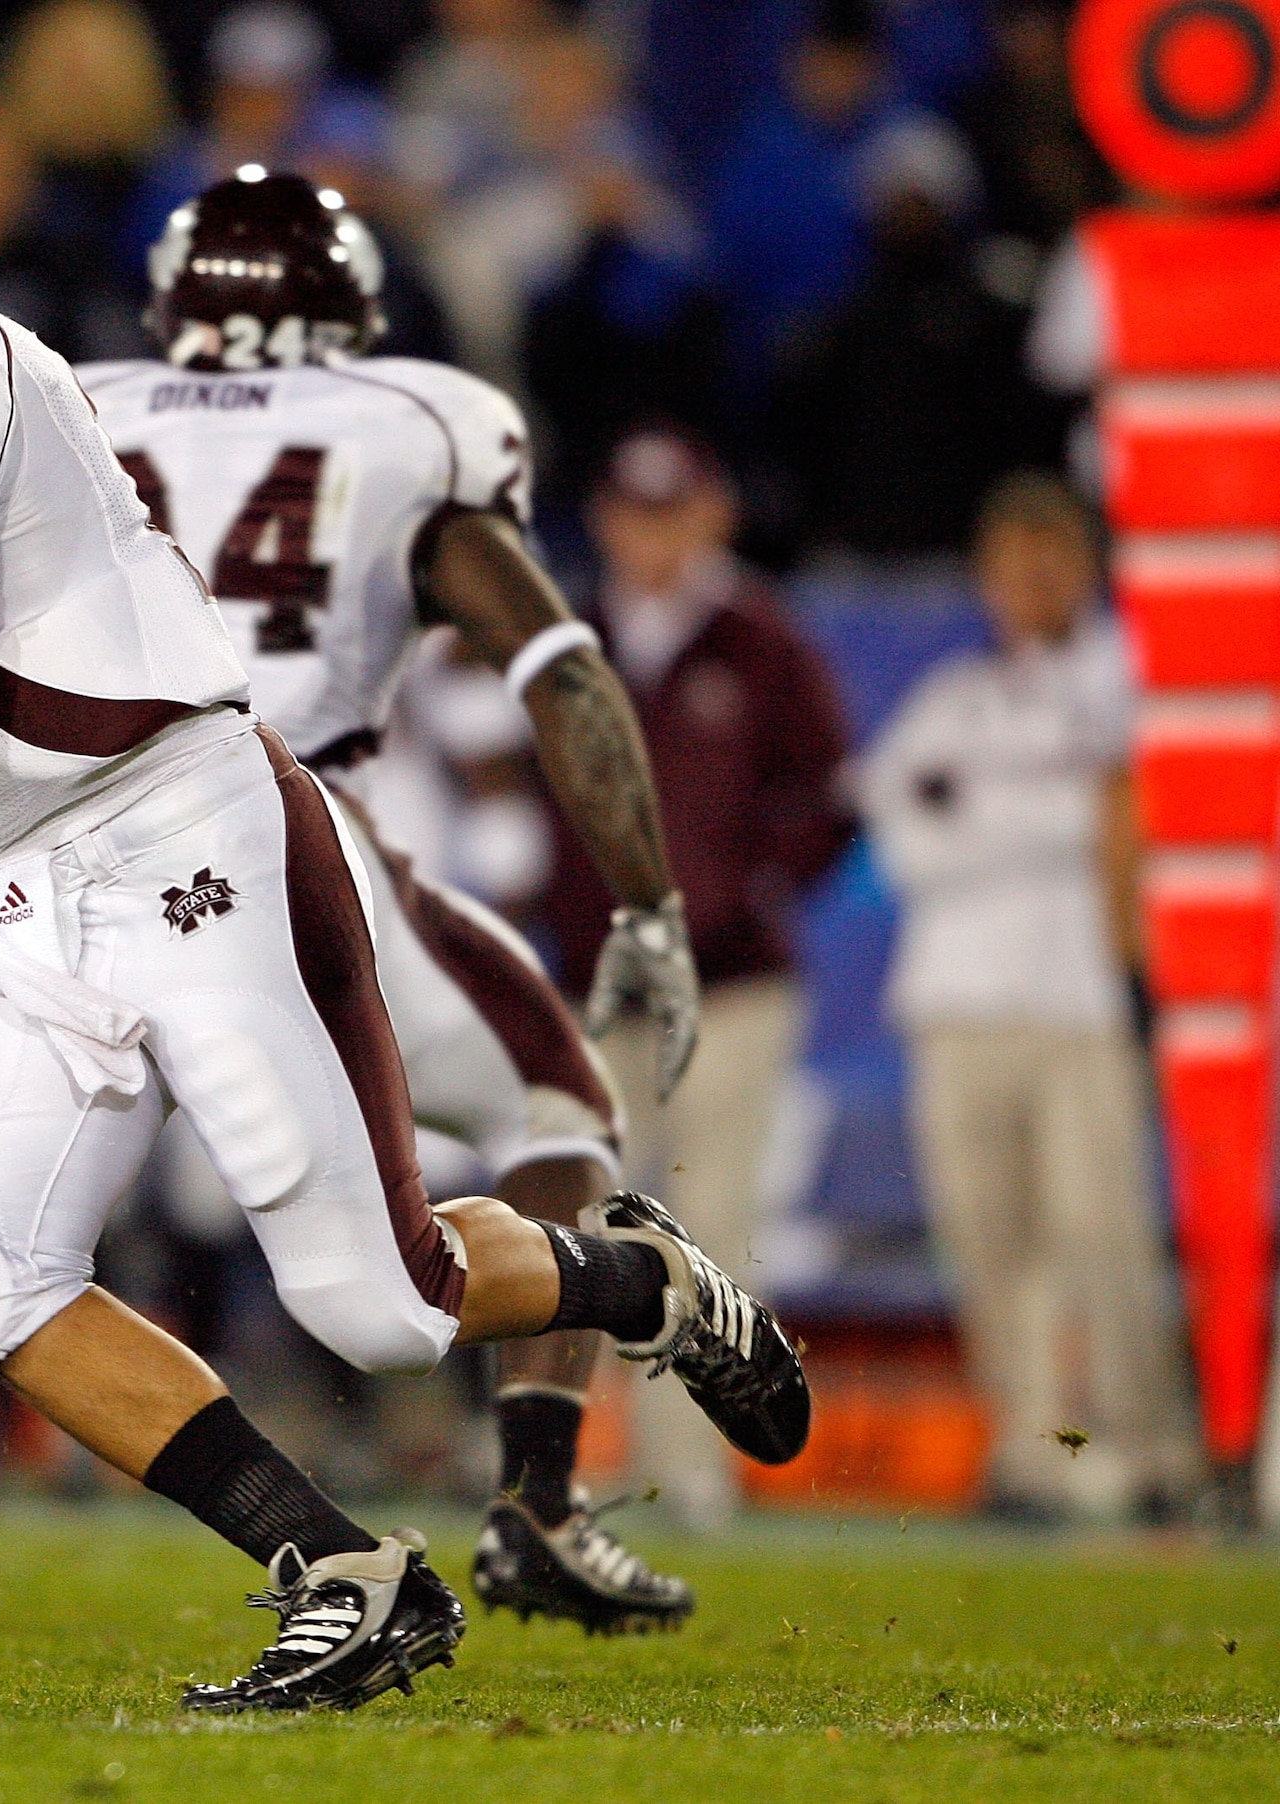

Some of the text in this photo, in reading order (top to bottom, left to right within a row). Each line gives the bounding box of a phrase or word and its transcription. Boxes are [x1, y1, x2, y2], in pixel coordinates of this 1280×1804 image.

[221, 313, 306, 370] 24
[147, 381, 272, 413] DIXON
[173, 886, 222, 919] STATE
